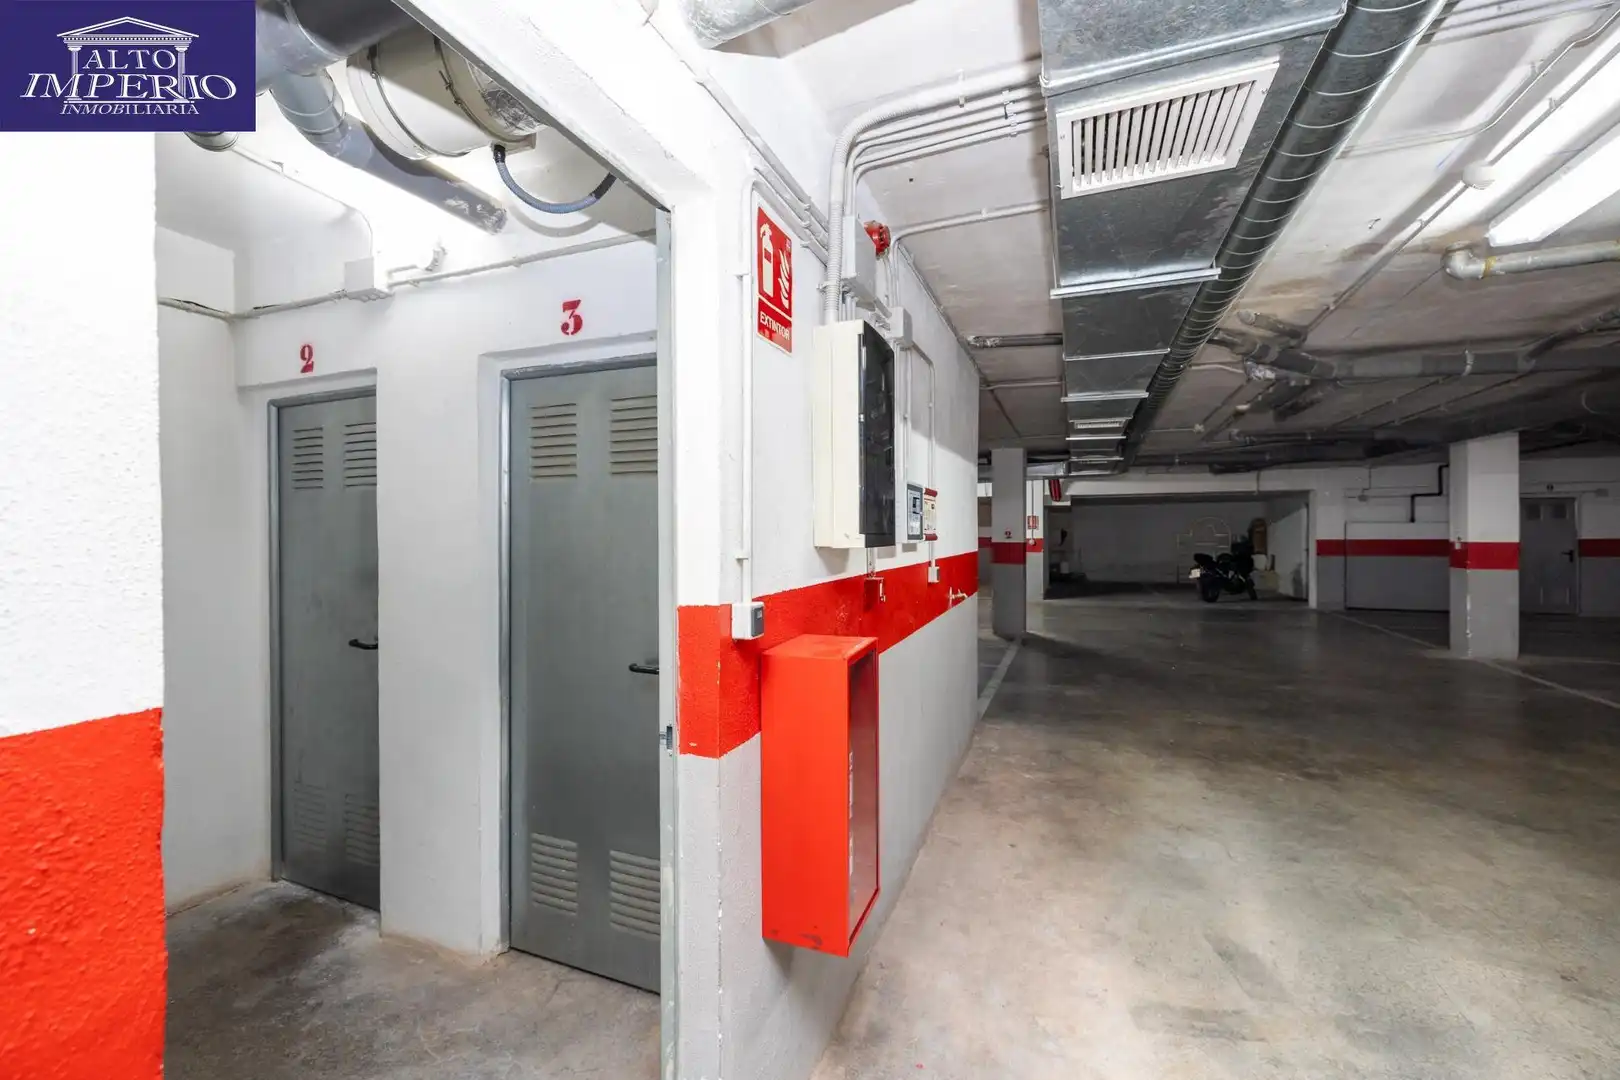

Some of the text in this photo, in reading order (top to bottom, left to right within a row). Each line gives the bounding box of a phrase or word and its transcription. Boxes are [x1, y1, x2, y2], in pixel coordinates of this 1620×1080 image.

[560, 298, 584, 336] 3
[759, 310, 791, 341] EXTINTOR
[299, 343, 315, 374] 2
